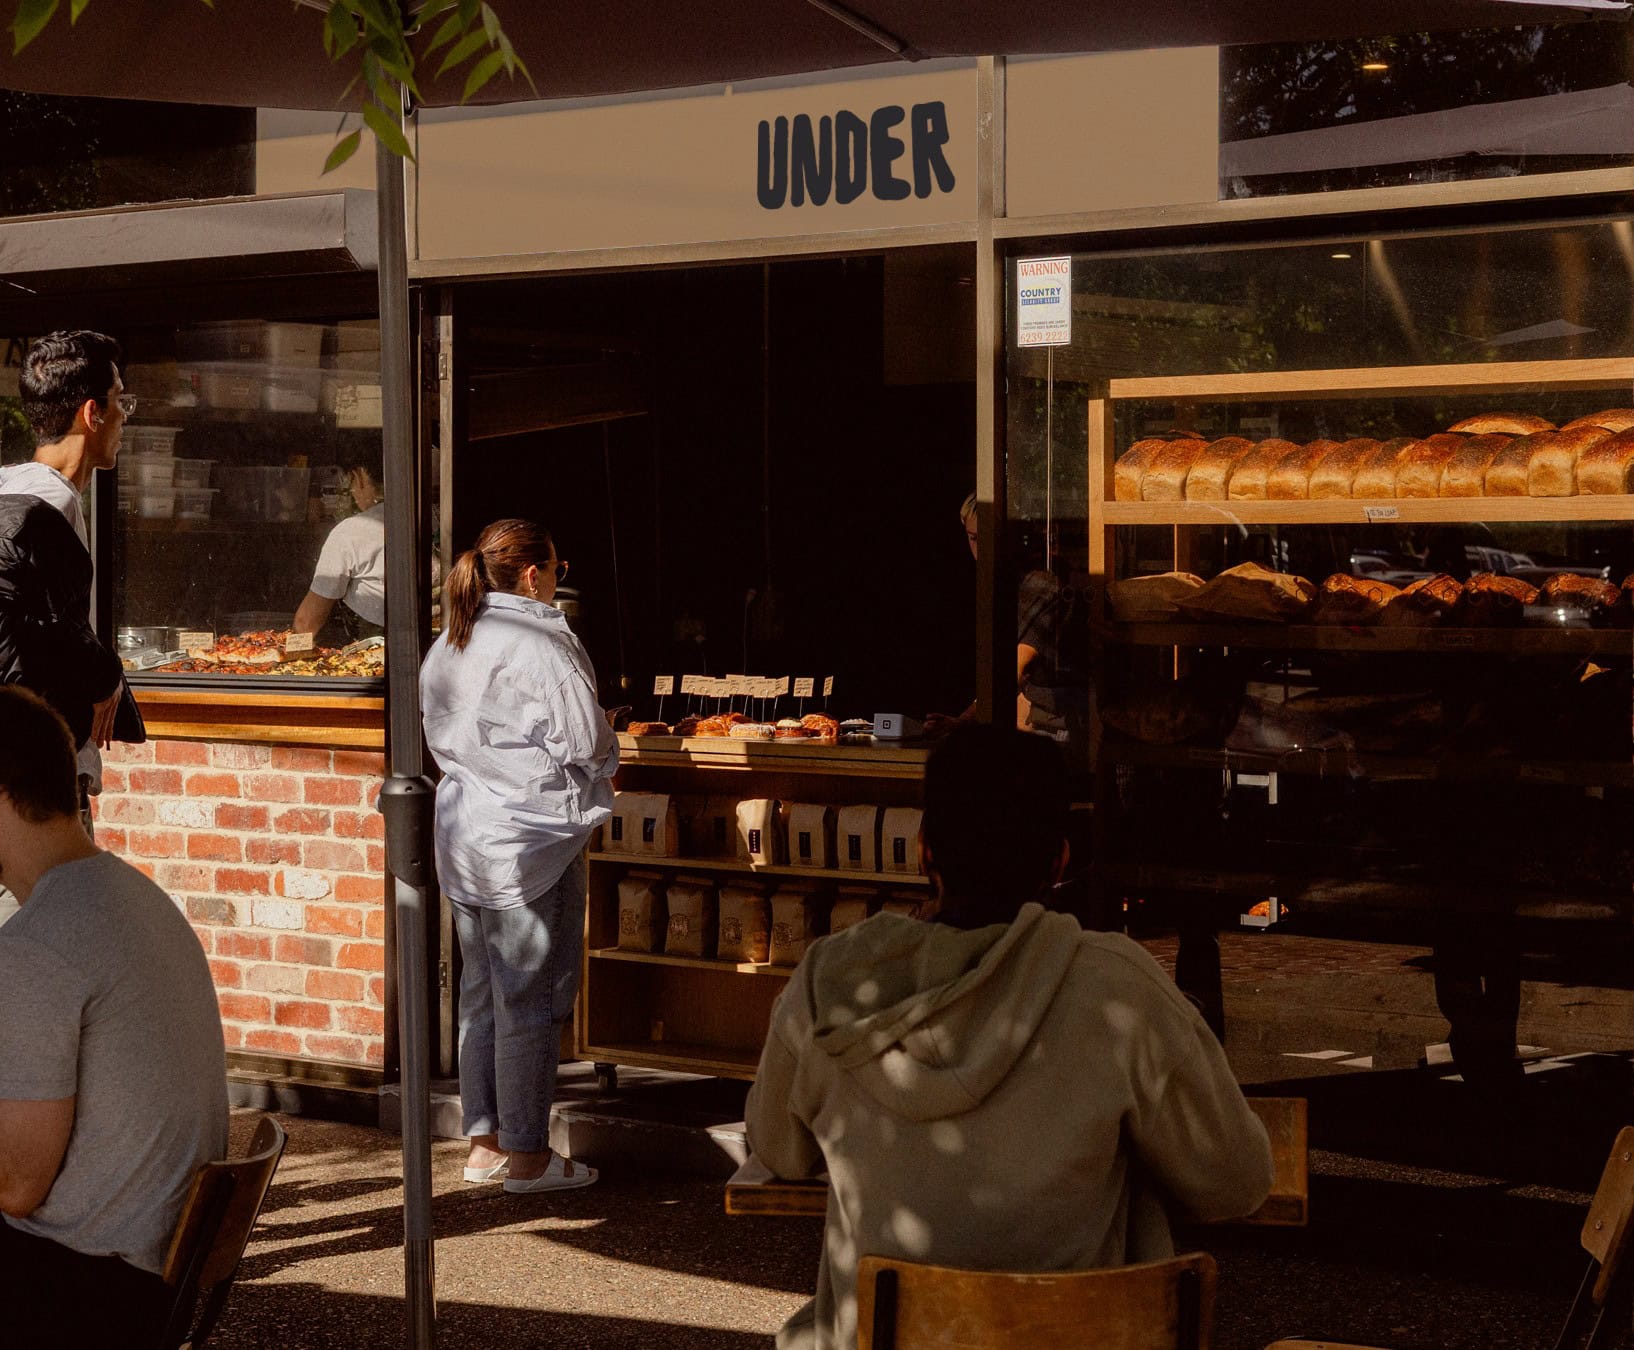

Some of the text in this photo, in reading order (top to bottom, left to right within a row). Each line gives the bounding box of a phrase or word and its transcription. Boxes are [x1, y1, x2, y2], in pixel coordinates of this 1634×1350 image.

[757, 101, 955, 209] UNDER
[1020, 261, 1068, 277] WARNING
[1020, 287, 1061, 298] COUNTRY
